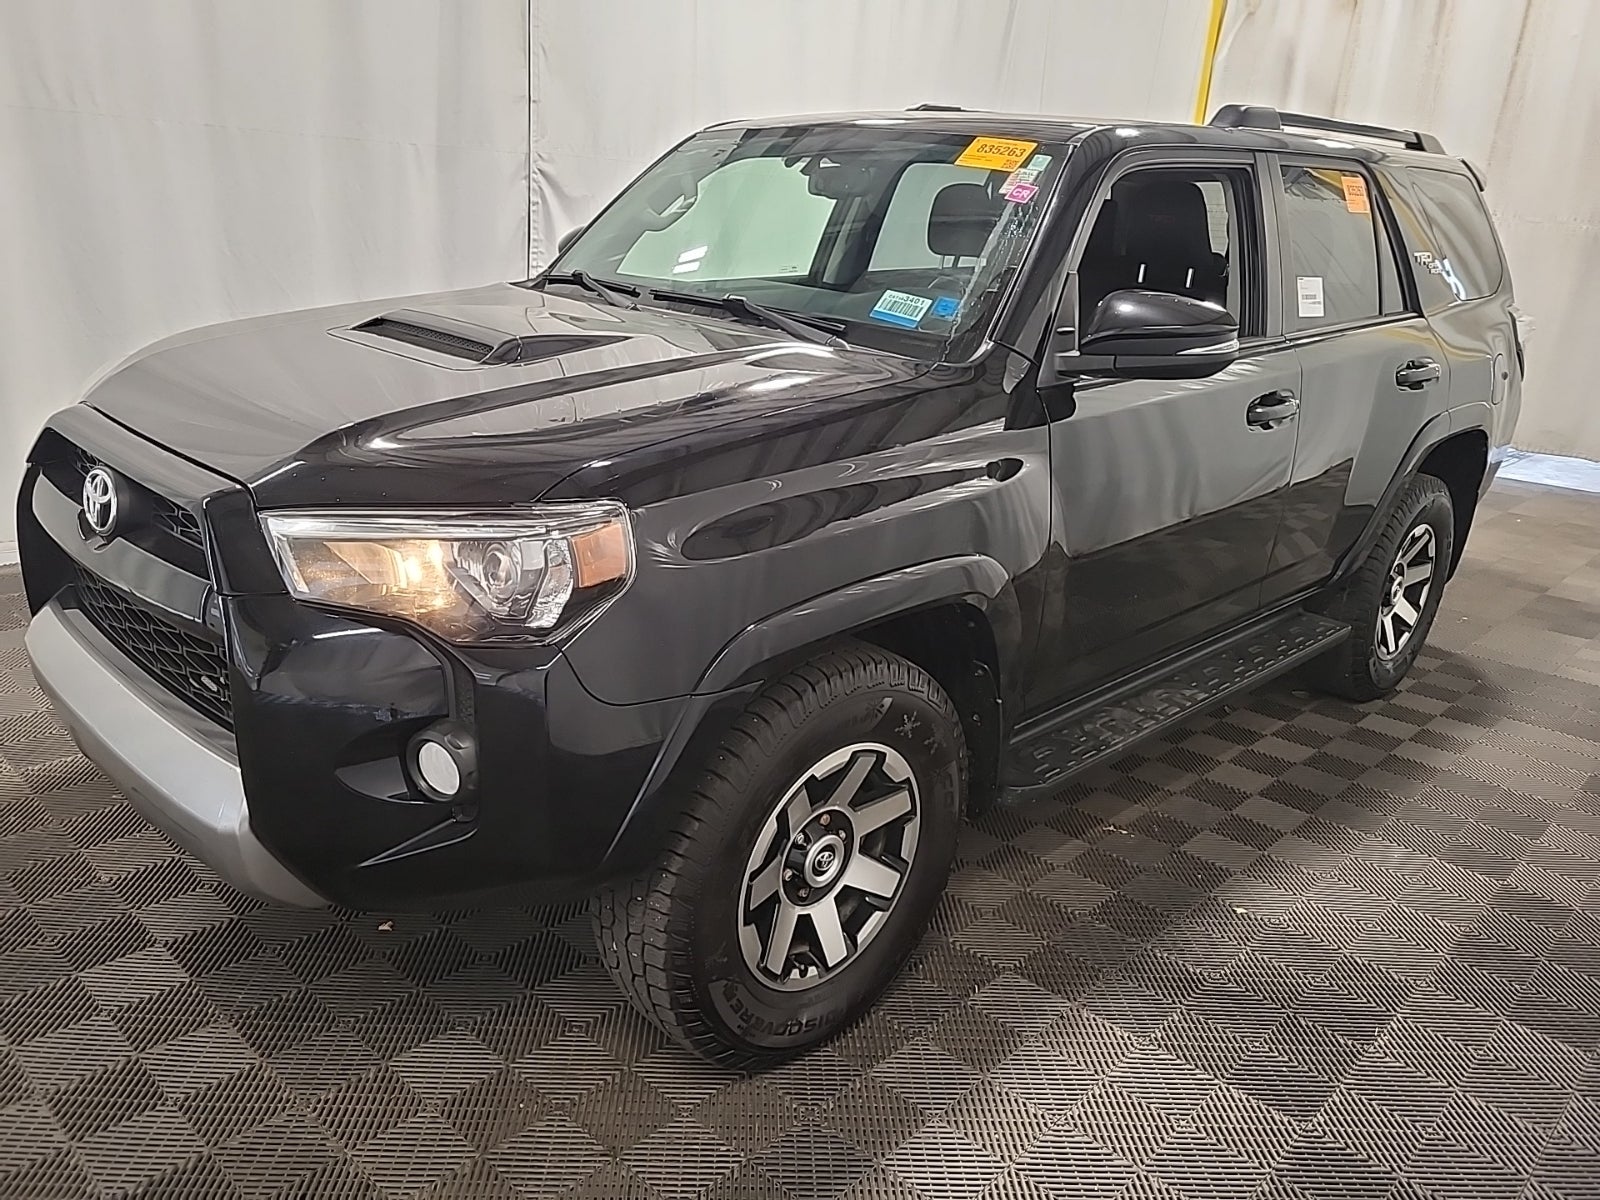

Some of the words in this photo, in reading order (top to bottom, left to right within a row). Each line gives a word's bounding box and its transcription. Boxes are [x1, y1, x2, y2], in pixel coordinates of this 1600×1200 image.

[977, 144, 1026, 158] 835263
[1012, 188, 1030, 198] CR
[1413, 252, 1432, 266] TRD
